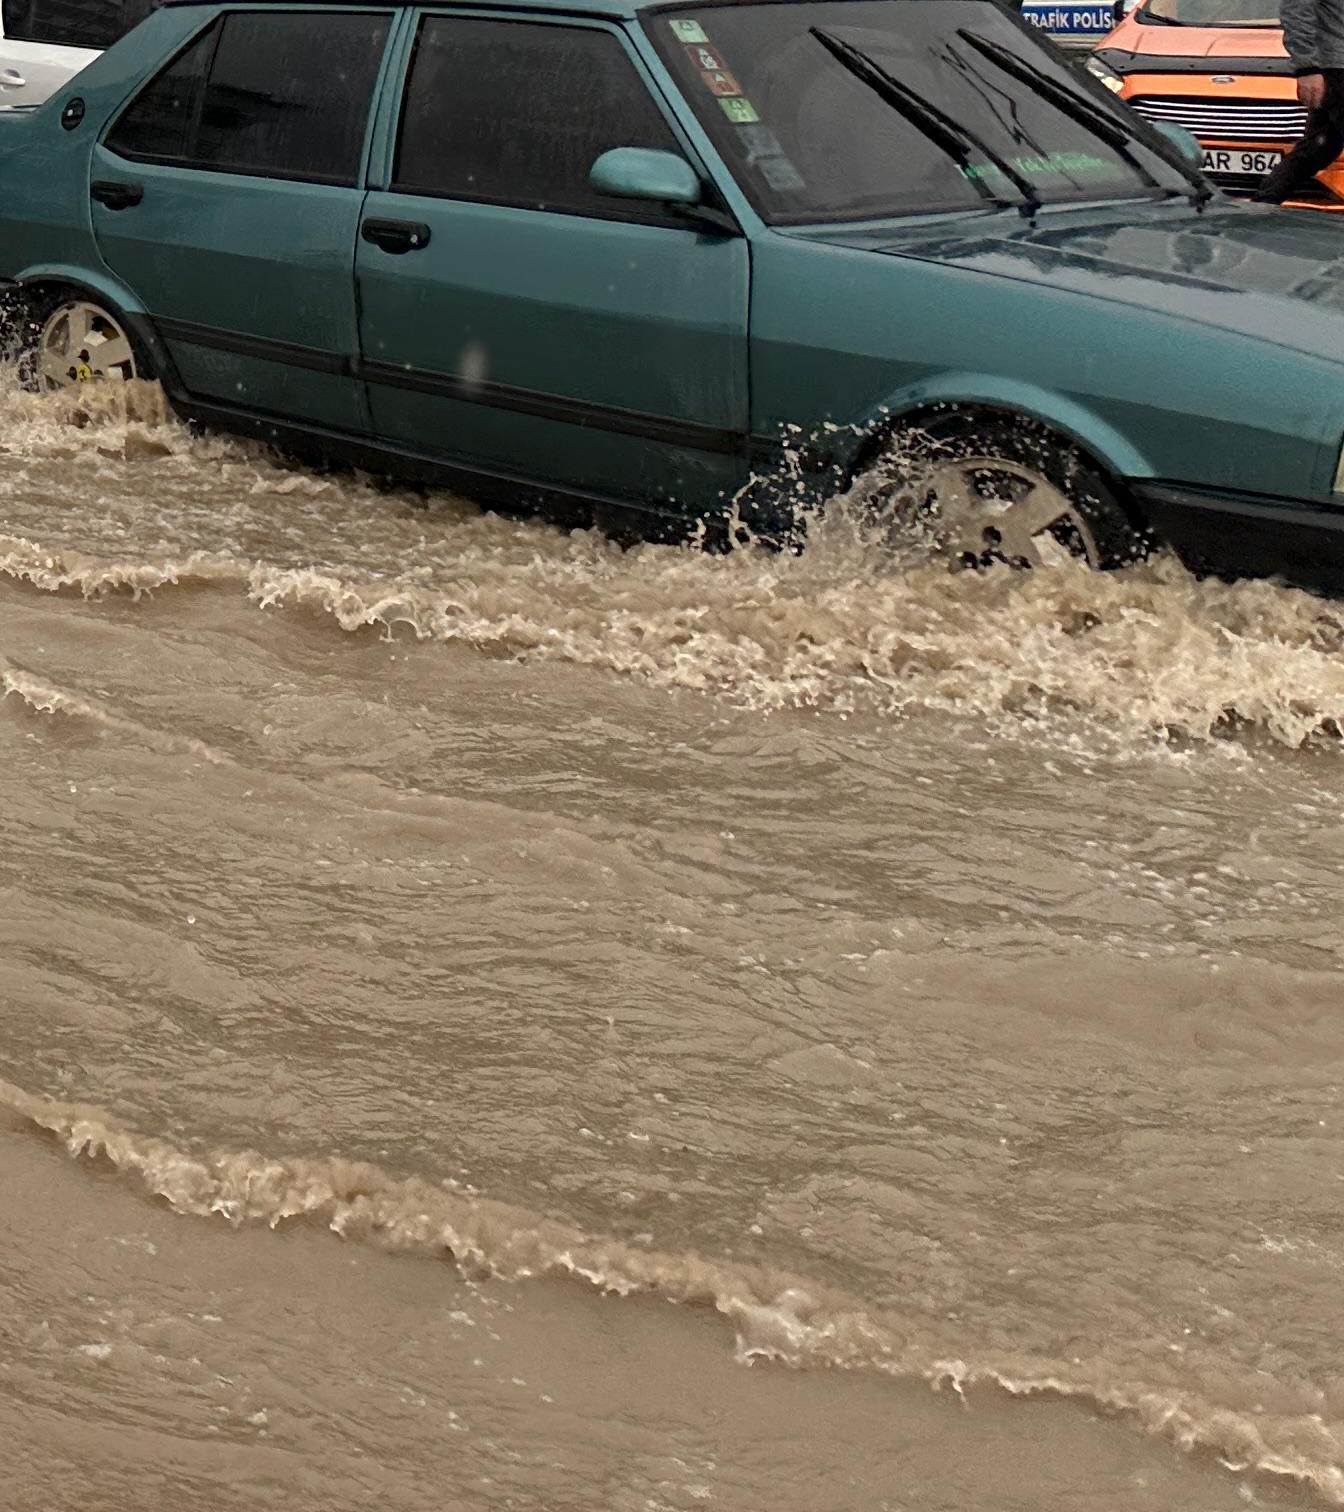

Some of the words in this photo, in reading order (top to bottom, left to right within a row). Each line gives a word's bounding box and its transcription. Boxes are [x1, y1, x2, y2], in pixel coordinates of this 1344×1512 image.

[1023, 8, 1069, 29] TRAFİK
[1073, 7, 1112, 29] POLİS
[1203, 151, 1231, 170] AR
